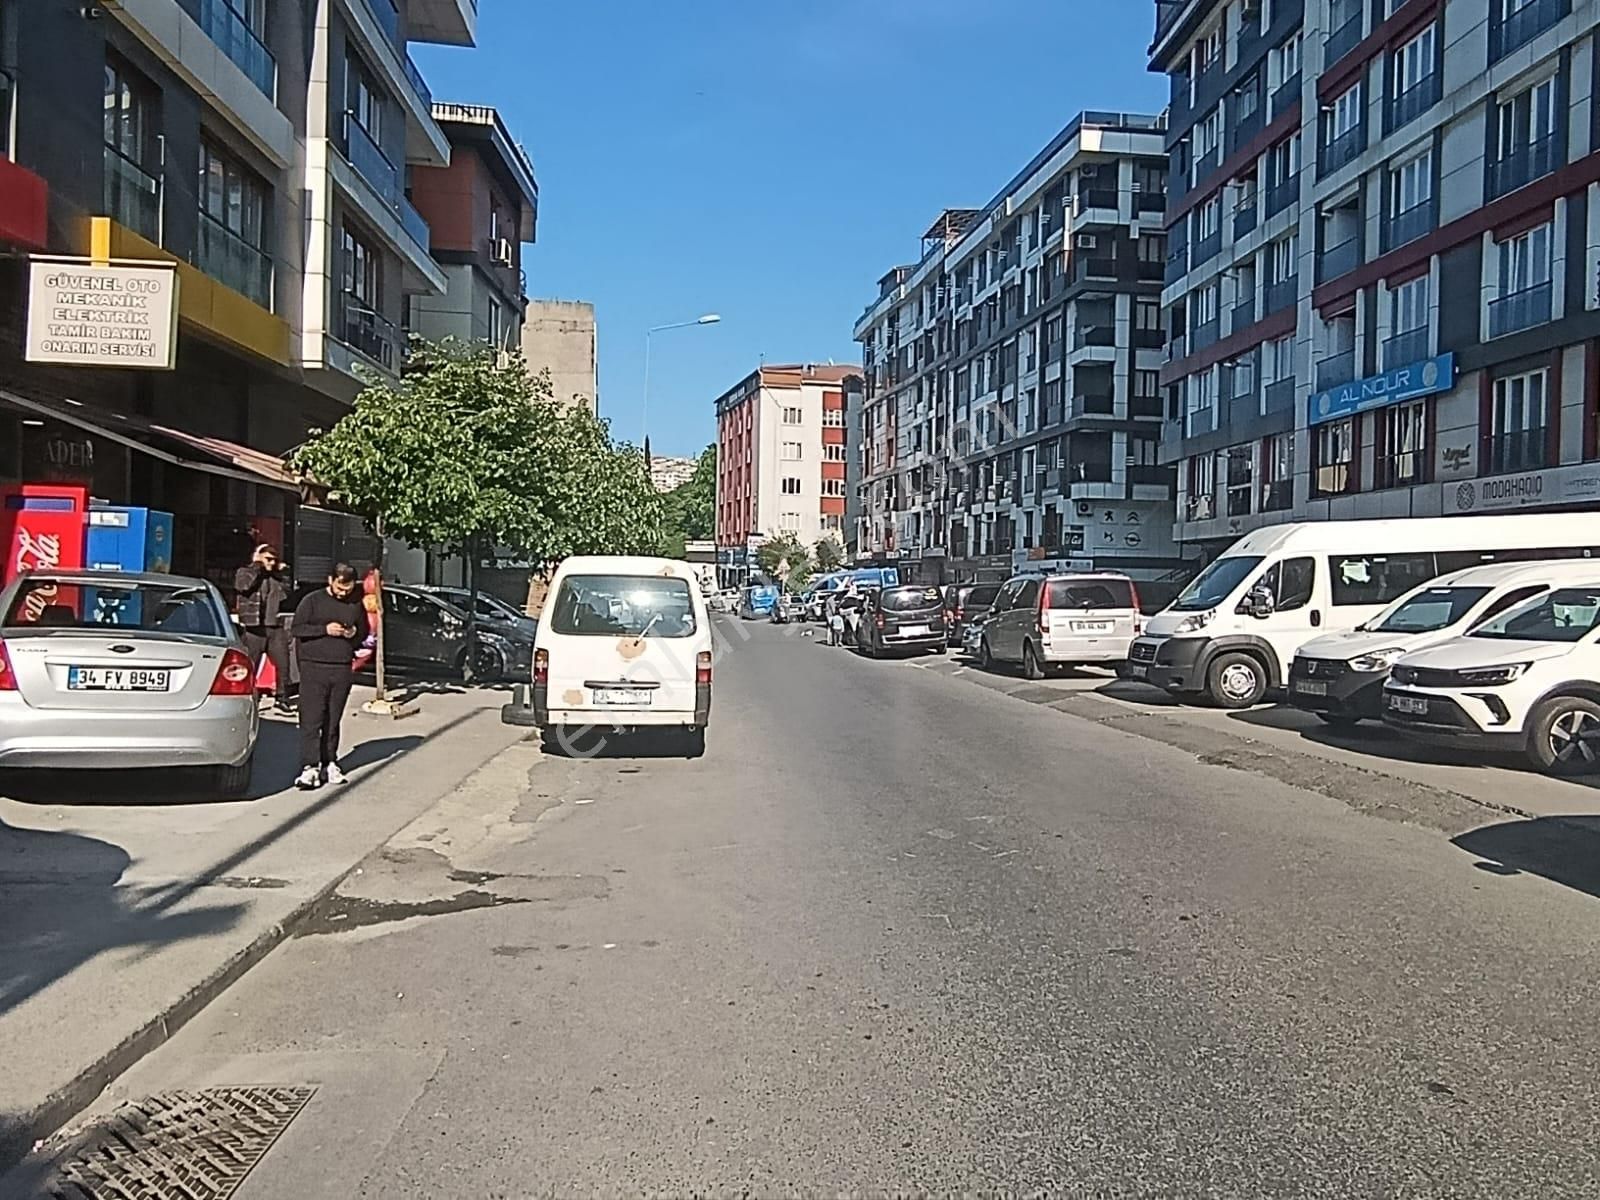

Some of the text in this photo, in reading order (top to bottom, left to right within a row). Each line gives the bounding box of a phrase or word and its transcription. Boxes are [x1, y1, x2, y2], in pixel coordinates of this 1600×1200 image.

[45, 273, 161, 293] GÜVENEL OTO
[56, 292, 147, 308] MEKANİK
[53, 308, 149, 324] ELEKTRİK
[48, 324, 151, 340] TAMİR BAKIM
[41, 340, 157, 357] ONARIM SERVİSİ
[1340, 369, 1411, 402] AL NOUR
[79, 670, 97, 684] 34
[129, 671, 166, 685] 8949
